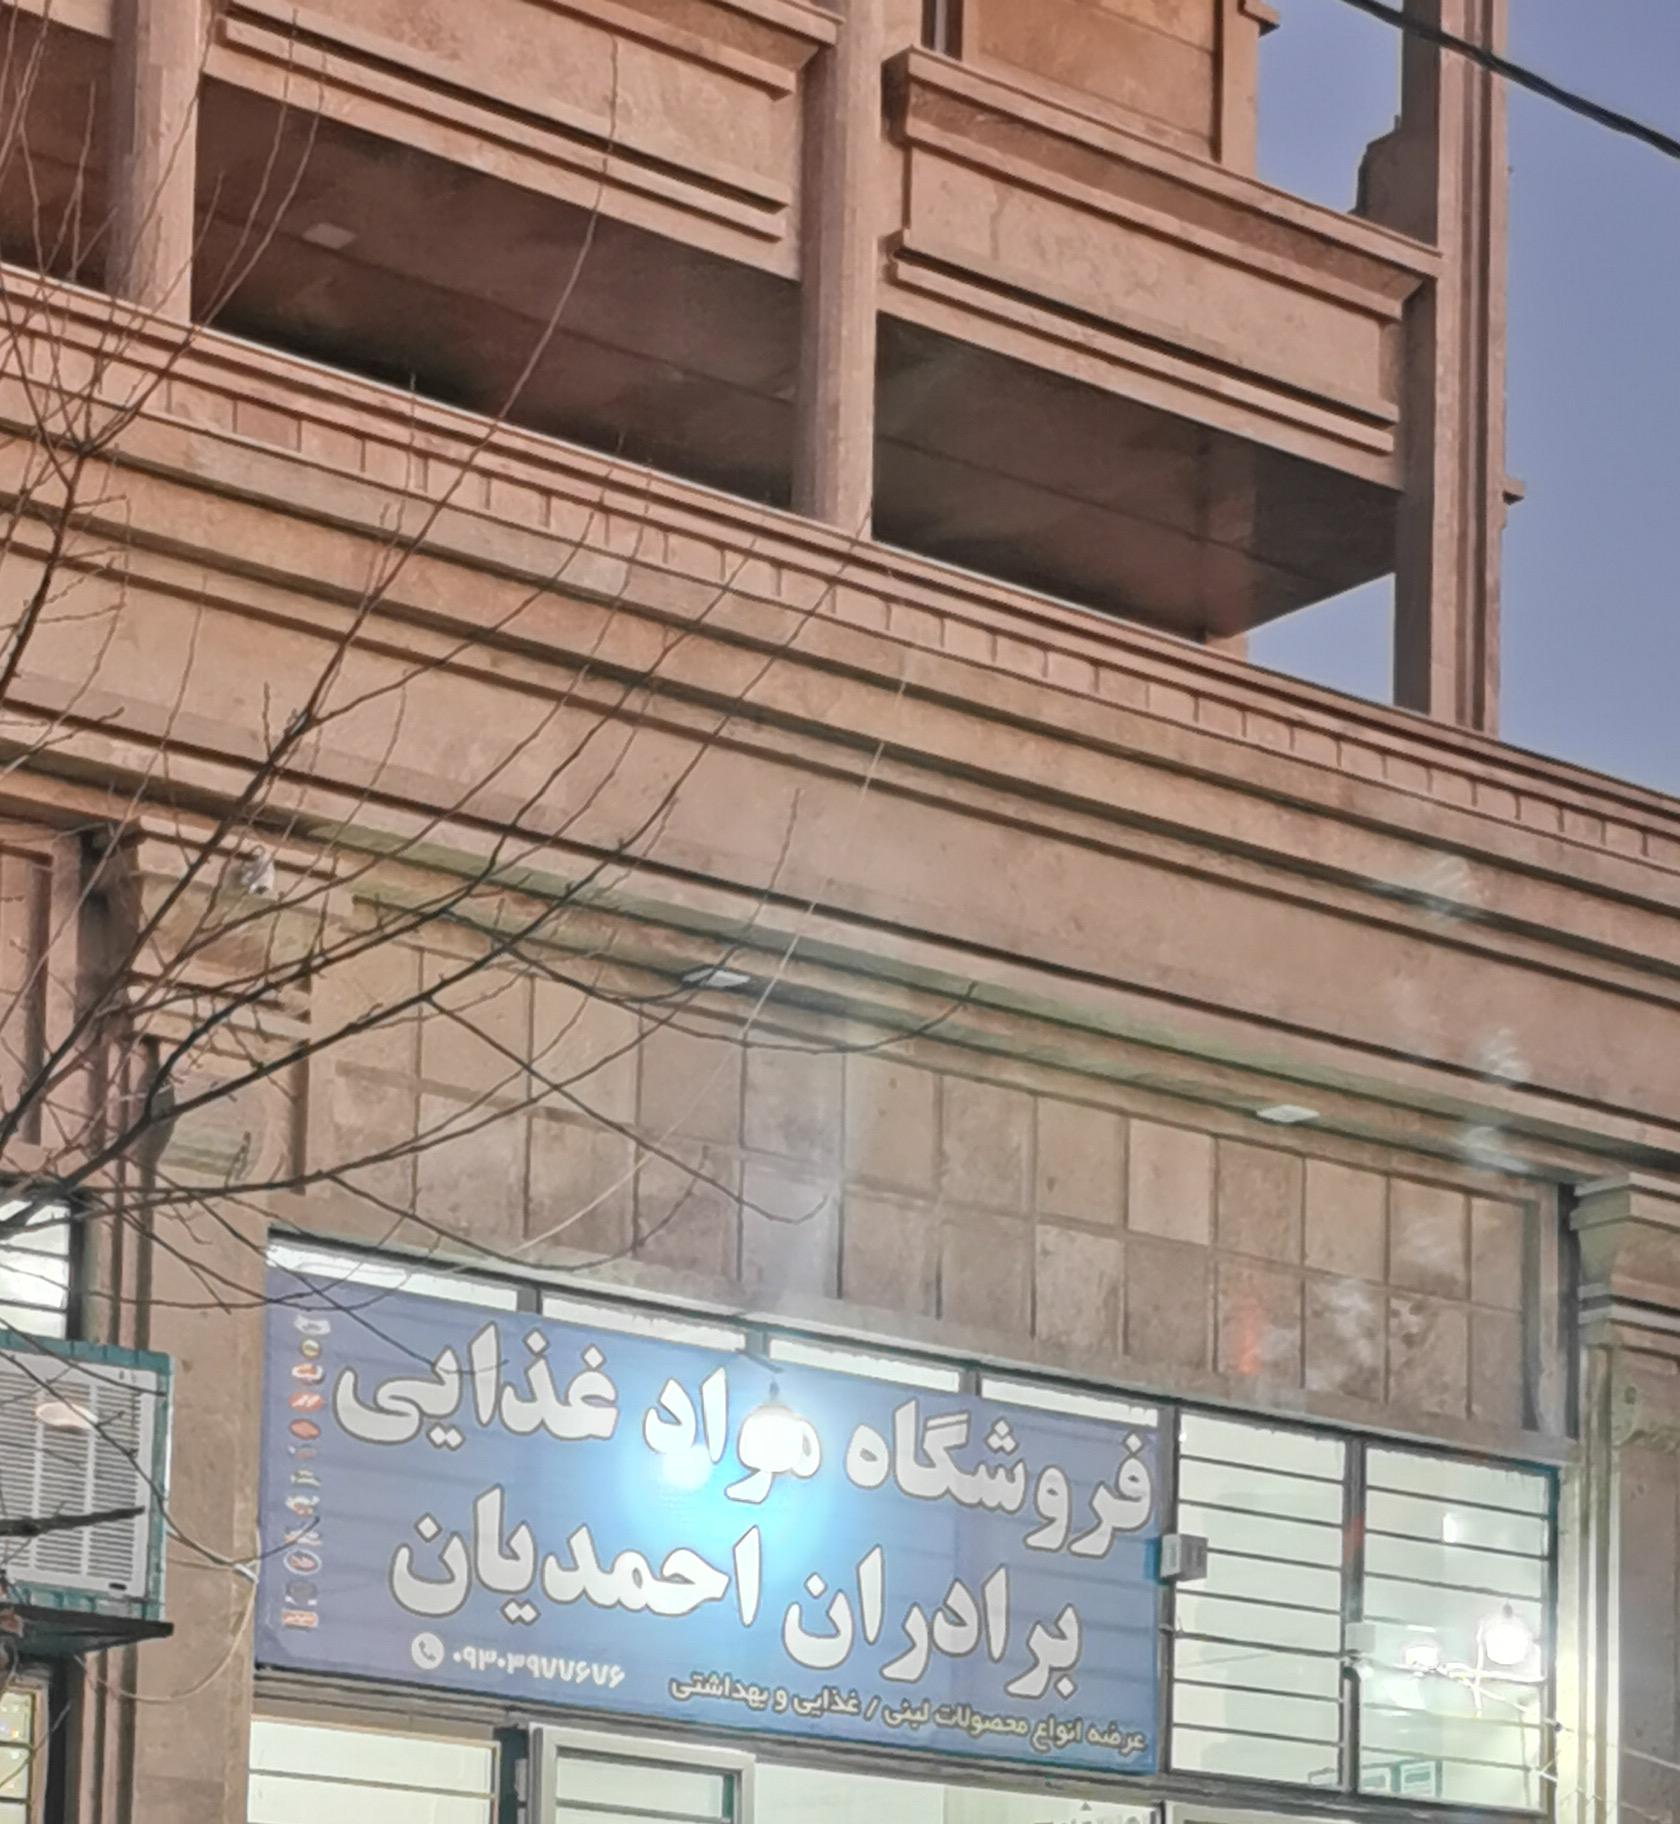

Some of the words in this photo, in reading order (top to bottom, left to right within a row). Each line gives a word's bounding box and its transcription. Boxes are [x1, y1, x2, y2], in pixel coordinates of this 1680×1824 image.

[332, 1323, 619, 1451] غذایی
[643, 1368, 822, 1504] مواد
[846, 1398, 1154, 1559] فروشگاه
[390, 1486, 763, 1626] احمدیان
[781, 1546, 1081, 1700] برادران
[669, 1671, 770, 1710] بهداشتی
[773, 1687, 789, 1713] و
[793, 1687, 861, 1717] غذایی
[935, 1704, 1029, 1737] محصولات
[1031, 1714, 1083, 1751] انواع
[1086, 1723, 1148, 1756] عرضه
